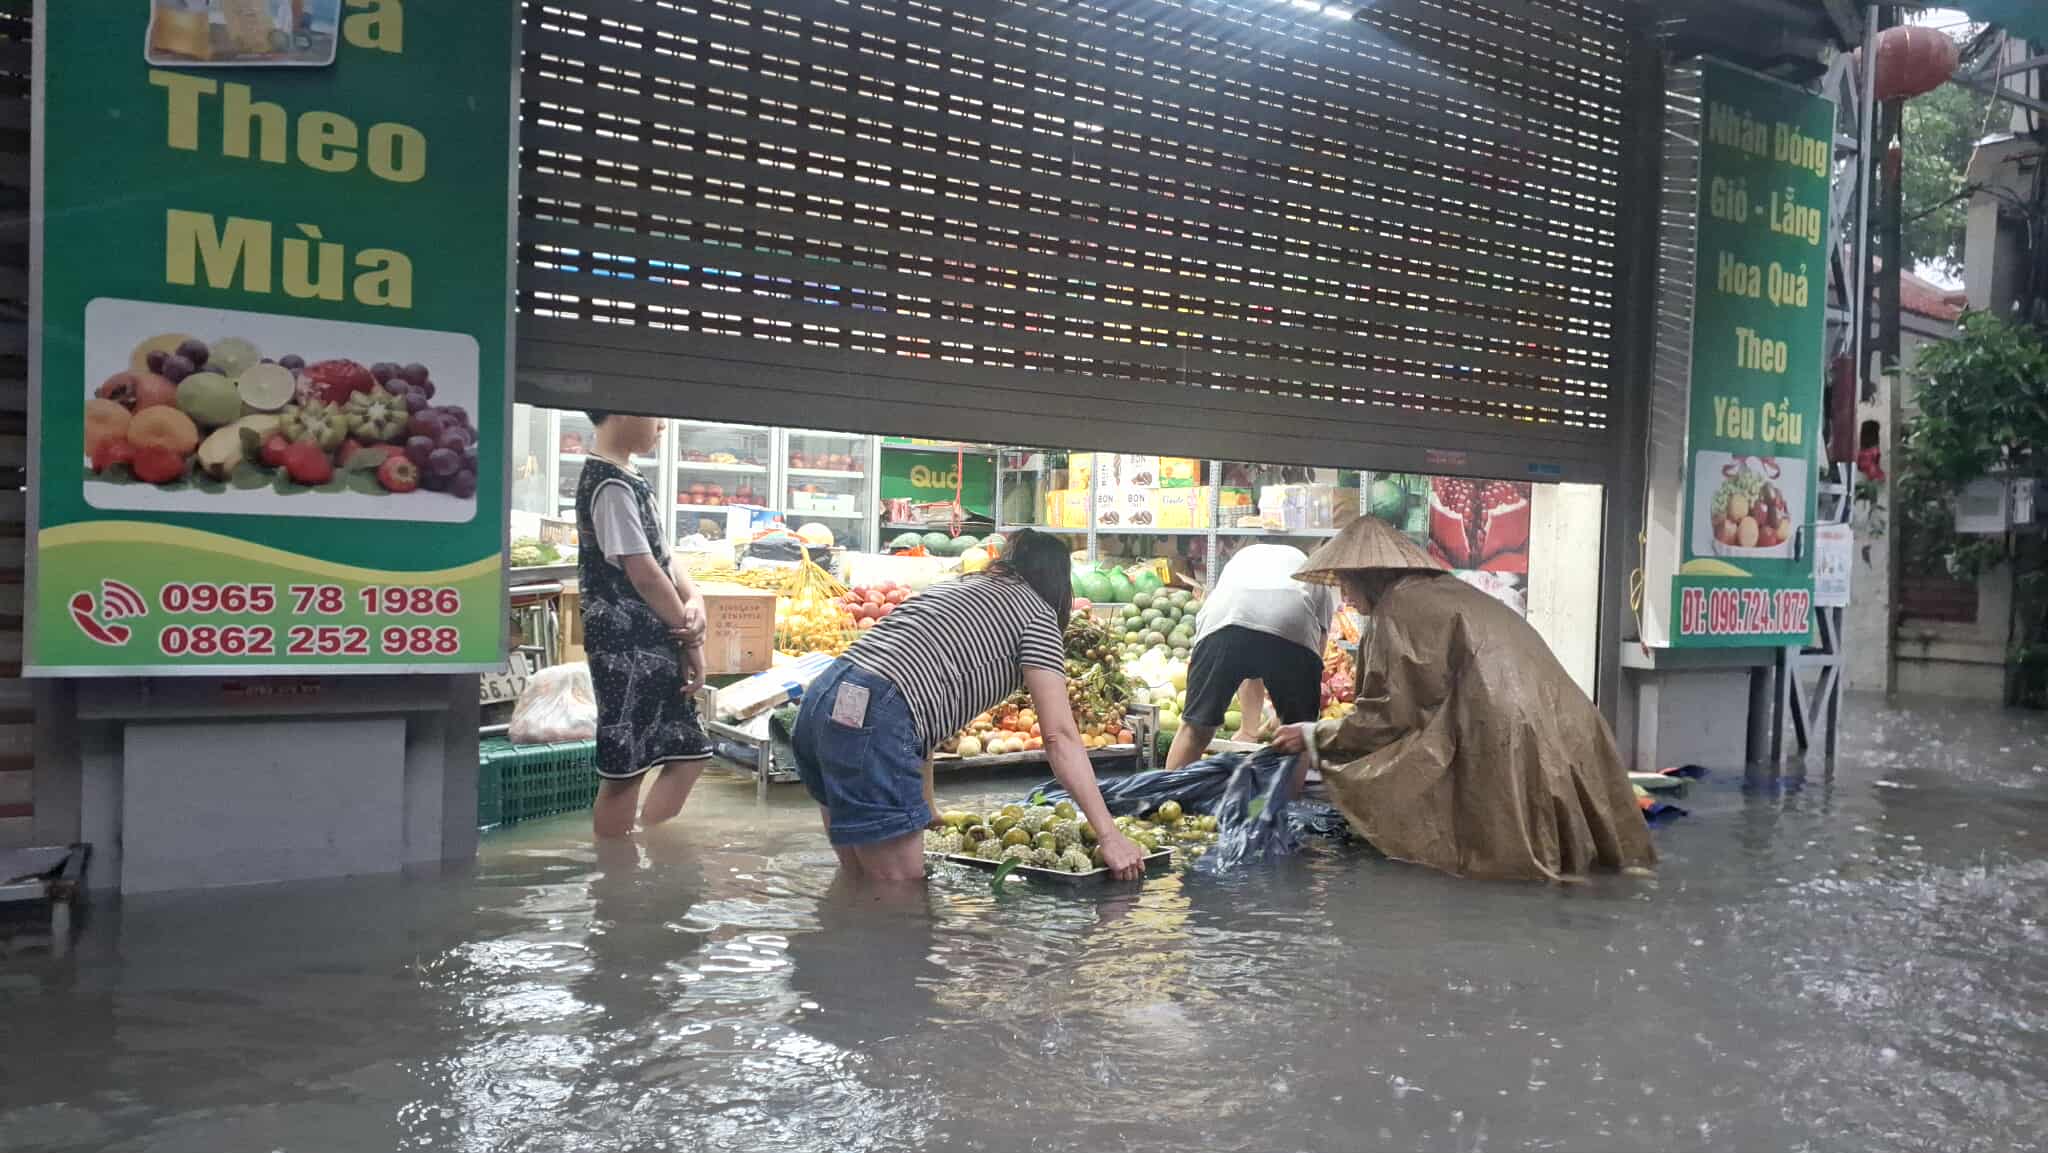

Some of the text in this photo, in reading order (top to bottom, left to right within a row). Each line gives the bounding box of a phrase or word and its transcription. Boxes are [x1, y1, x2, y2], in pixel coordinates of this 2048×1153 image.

[148, 69, 427, 183] Theo
[166, 208, 413, 309] Mùa
[1716, 251, 1809, 308] Hoa Quả
[1735, 327, 1788, 374] Theo
[1713, 396, 1755, 441] Yêu
[160, 583, 460, 616] 0965 78 1986
[159, 625, 460, 656] 0862 252 988
